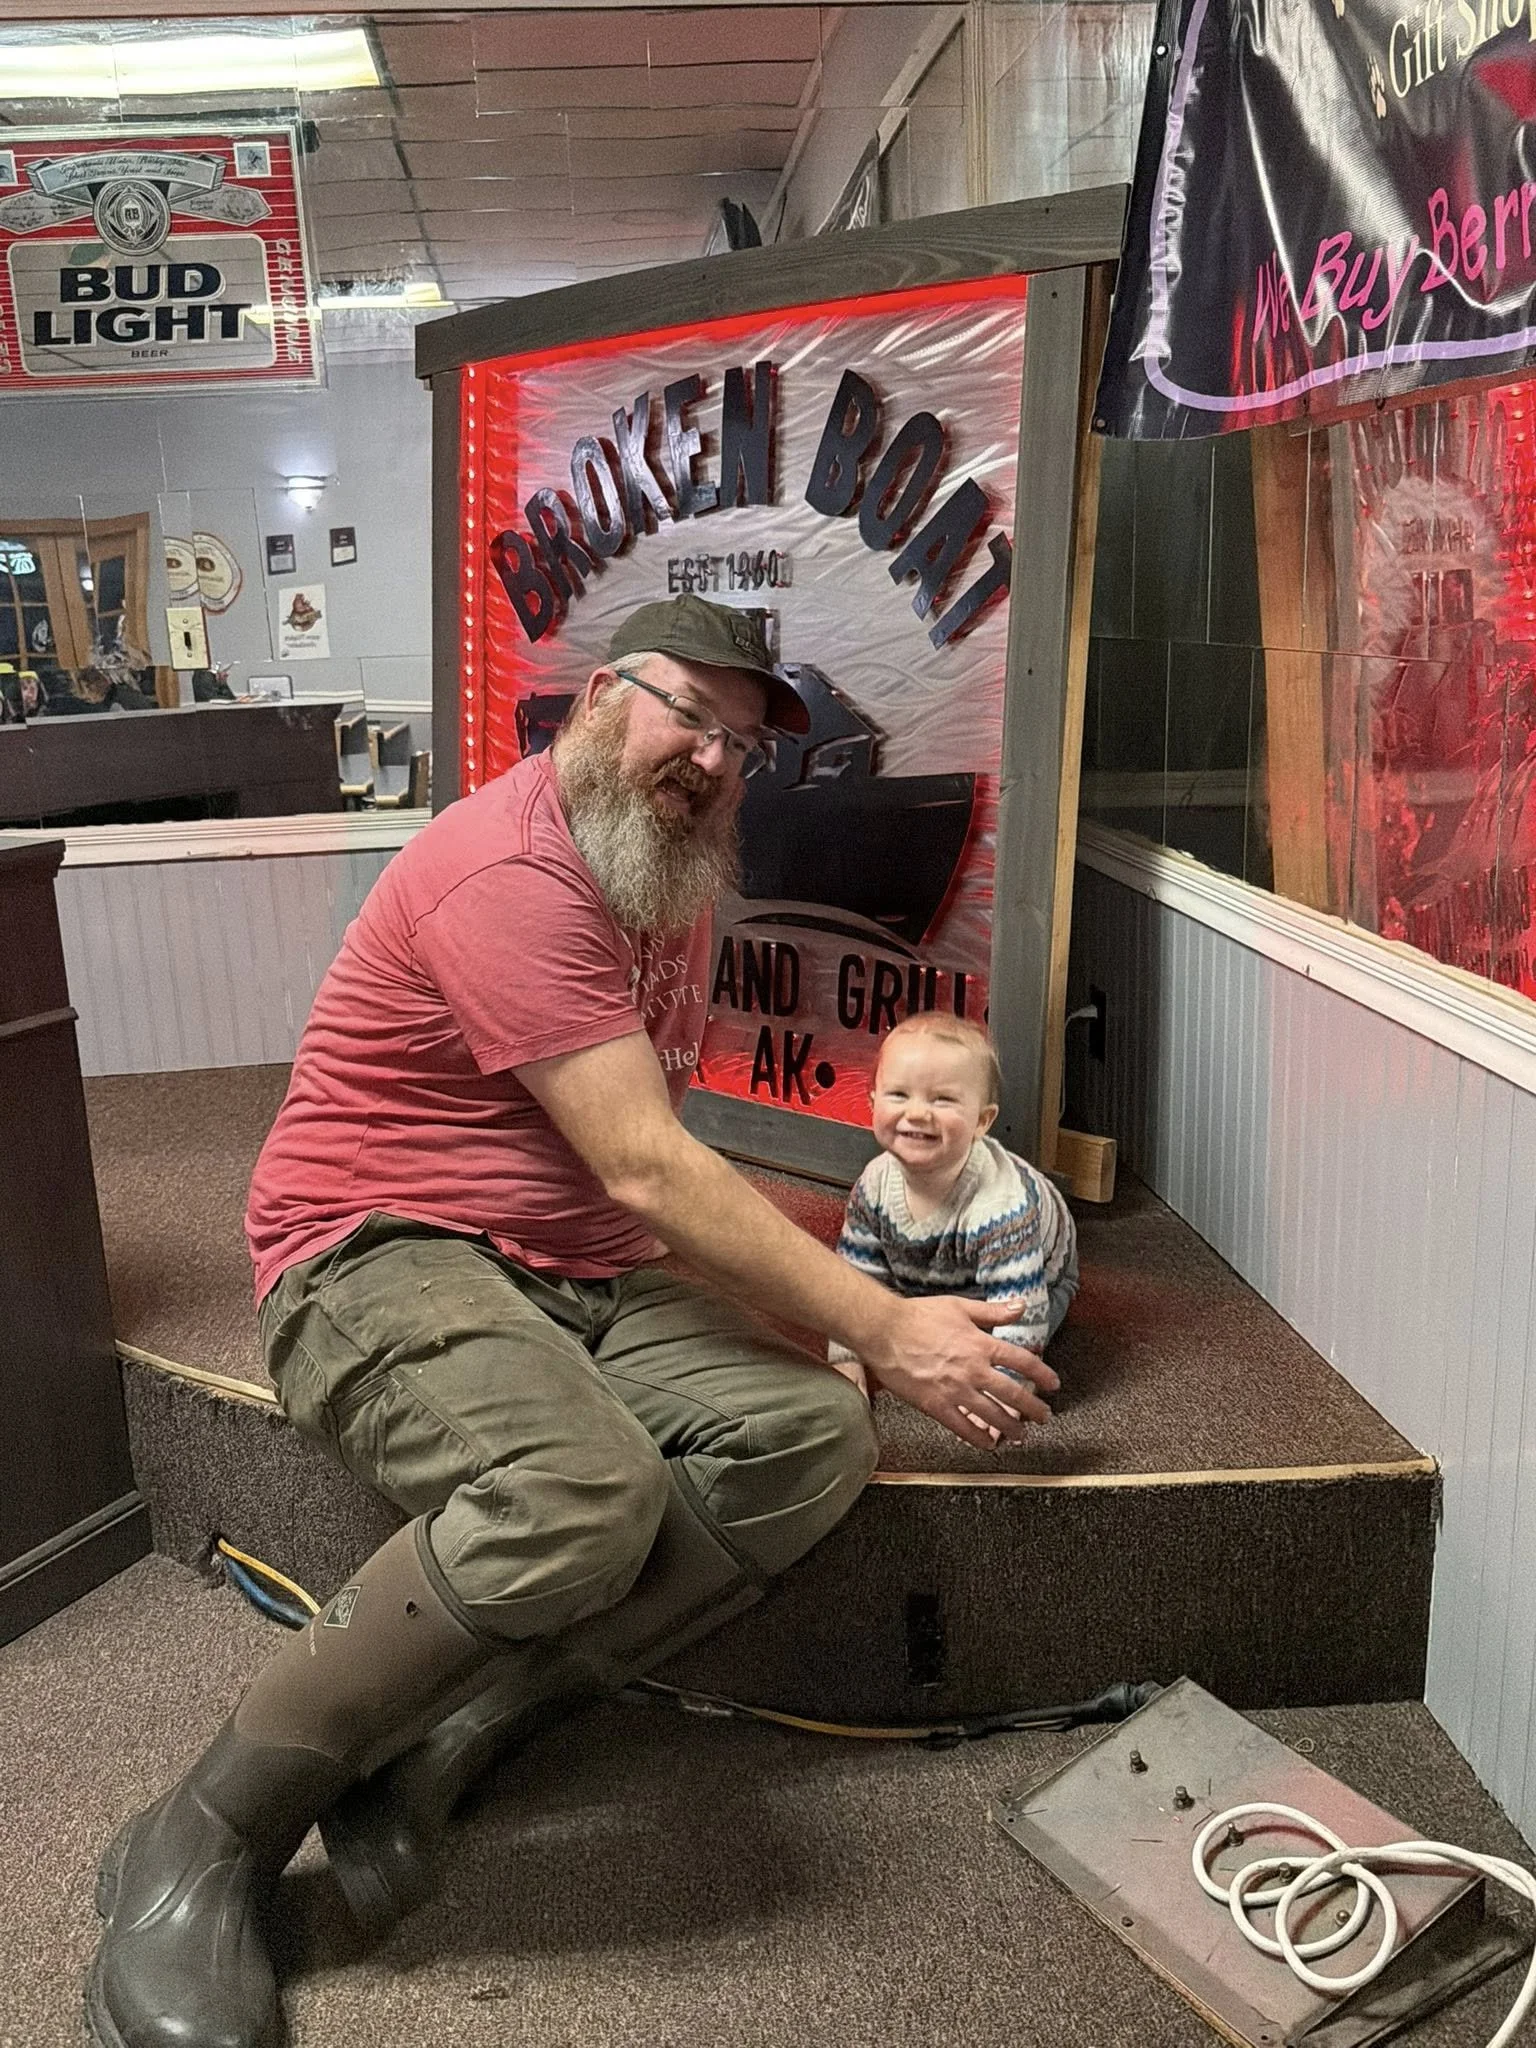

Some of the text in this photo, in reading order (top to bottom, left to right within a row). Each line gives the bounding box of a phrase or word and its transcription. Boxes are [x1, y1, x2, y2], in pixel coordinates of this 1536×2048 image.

[1389, 0, 1447, 98] Gift
[60, 262, 224, 304] BUD
[1253, 250, 1291, 343] We
[1300, 230, 1421, 331] Buy
[33, 303, 252, 347] LIGHT
[130, 349, 169, 359] BEER
[488, 360, 1013, 651] BROKEN BOAT
[711, 935, 800, 1018] AND
